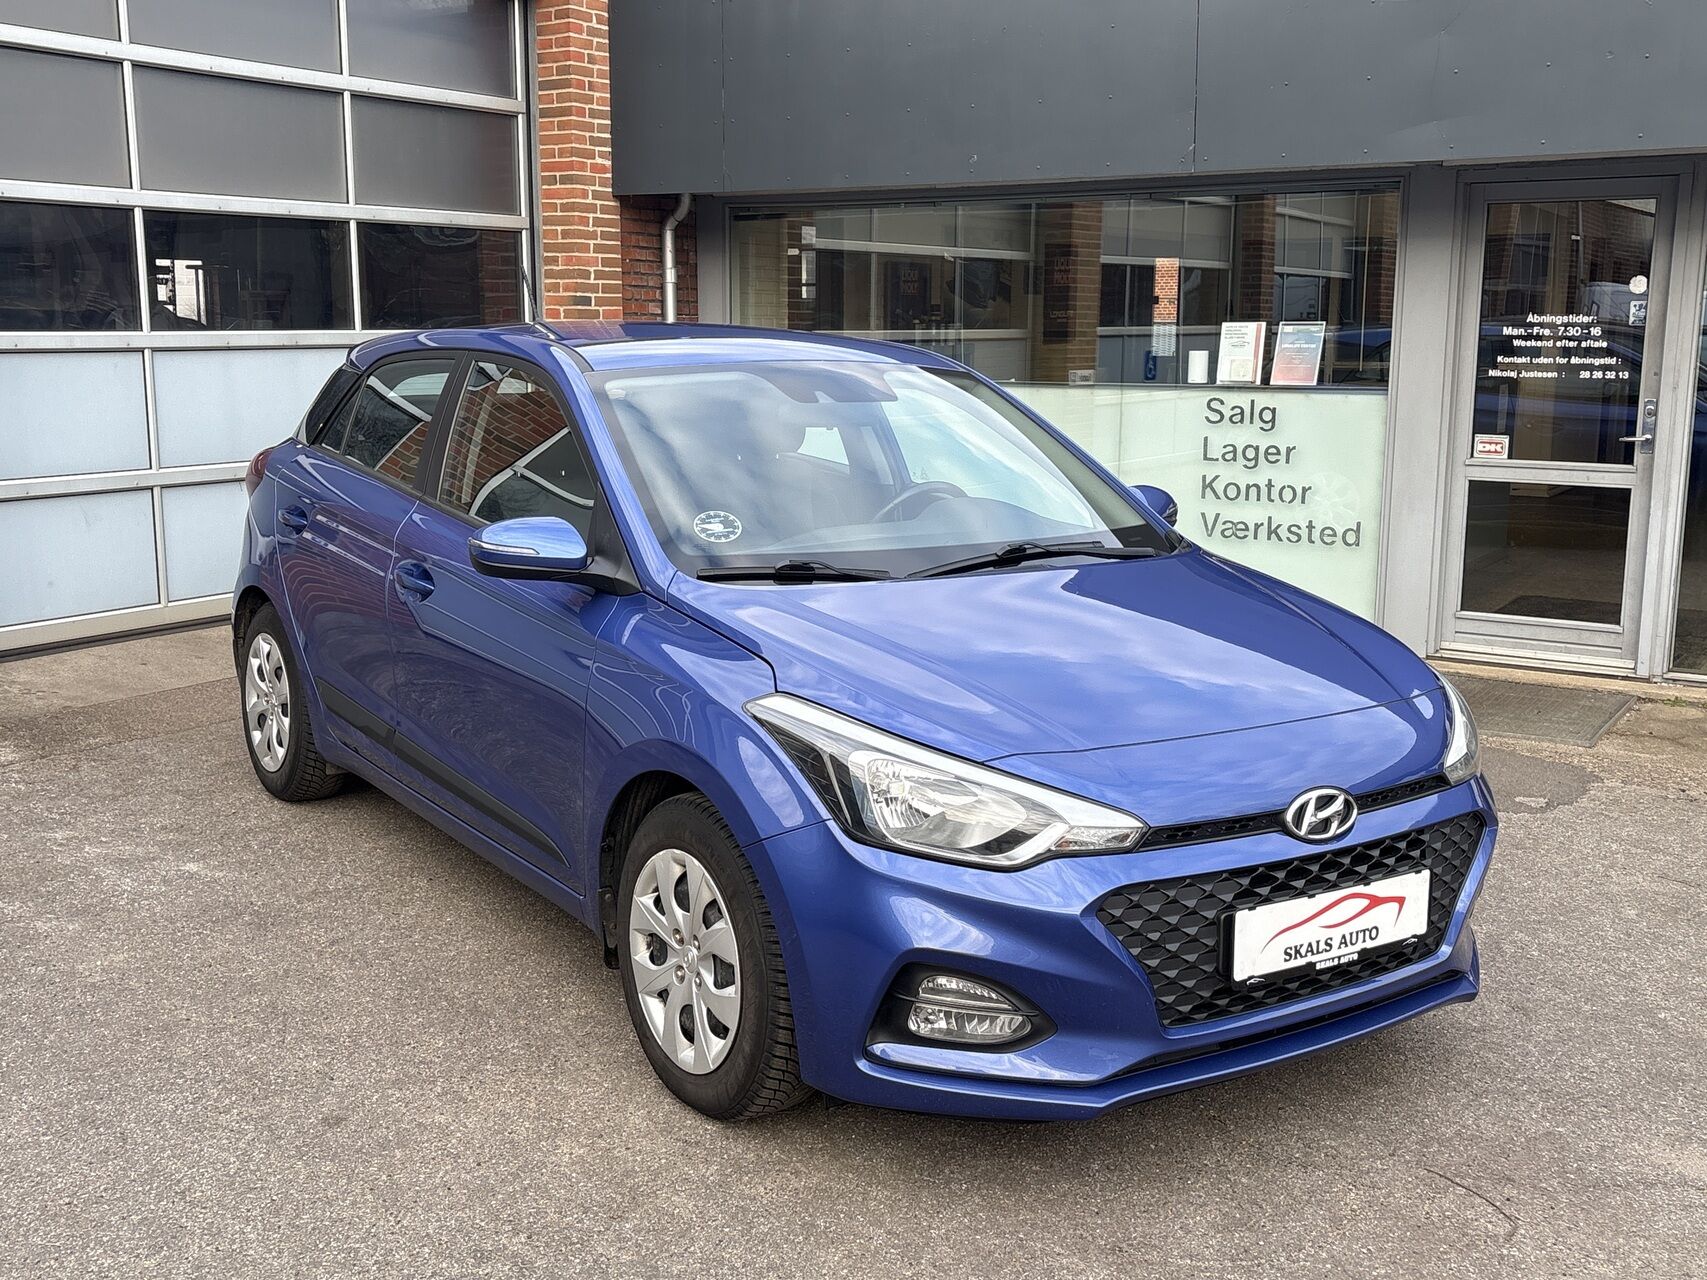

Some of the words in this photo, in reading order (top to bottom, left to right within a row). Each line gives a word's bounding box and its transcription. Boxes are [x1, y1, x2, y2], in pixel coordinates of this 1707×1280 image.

[1526, 312, 1597, 325] Åbningstider:
[1502, 326, 1553, 336] Man.-Fre.
[1512, 339, 1553, 347] Weekend
[1556, 339, 1578, 347] efter
[1581, 339, 1608, 348] aftale
[1497, 355, 1530, 363] Kontakt
[1532, 356, 1554, 364] uden
[1555, 356, 1569, 364] for
[1570, 356, 1616, 366] åbningstid
[1488, 369, 1518, 379] Nikolaj
[1519, 370, 1558, 378] Justesen
[1579, 371, 1591, 379] 28
[1592, 371, 1603, 379] 26
[1605, 371, 1616, 379] 32
[1618, 371, 1629, 379] 13
[1204, 397, 1278, 432] Salg
[1202, 436, 1297, 469] Lager
[1200, 474, 1312, 505] Kontor
[1200, 511, 1362, 547] Værksted
[1283, 937, 1333, 962] SKALS
[1337, 925, 1379, 950] AUTO
